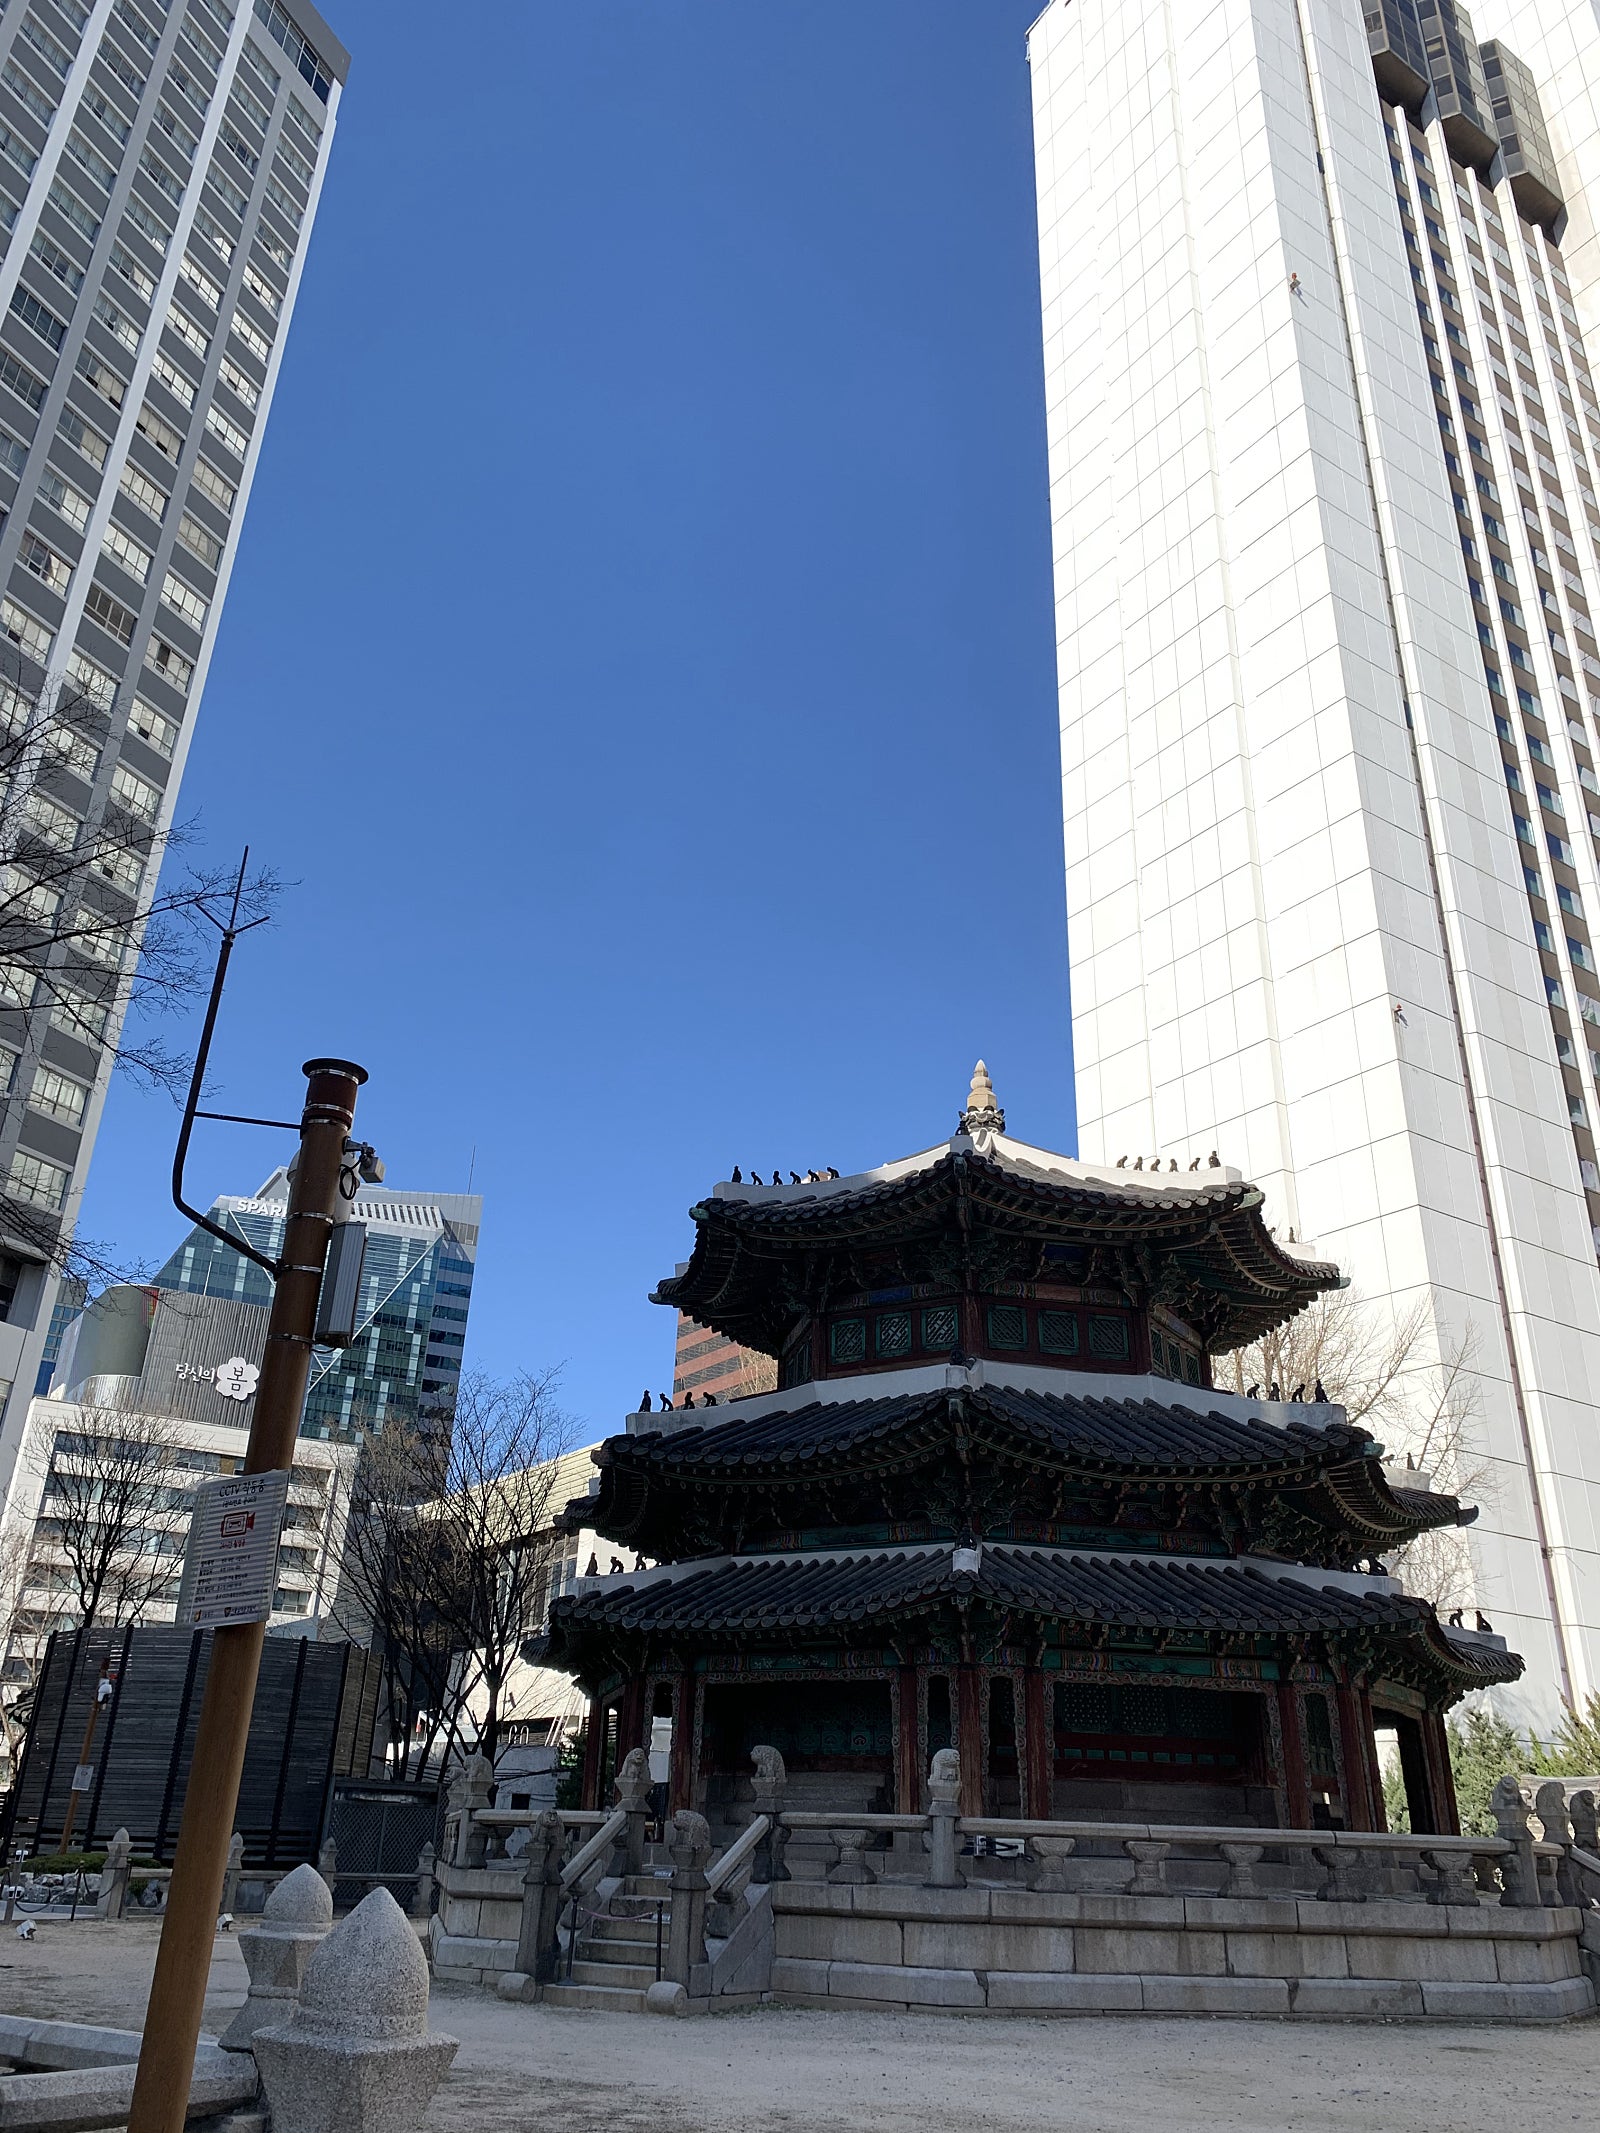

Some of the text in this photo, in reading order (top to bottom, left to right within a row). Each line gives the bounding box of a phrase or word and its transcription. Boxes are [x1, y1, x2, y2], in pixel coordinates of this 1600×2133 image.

[176, 1363, 248, 1391] 당신의 봄
[219, 1479, 266, 1498] CCTV 작동중
